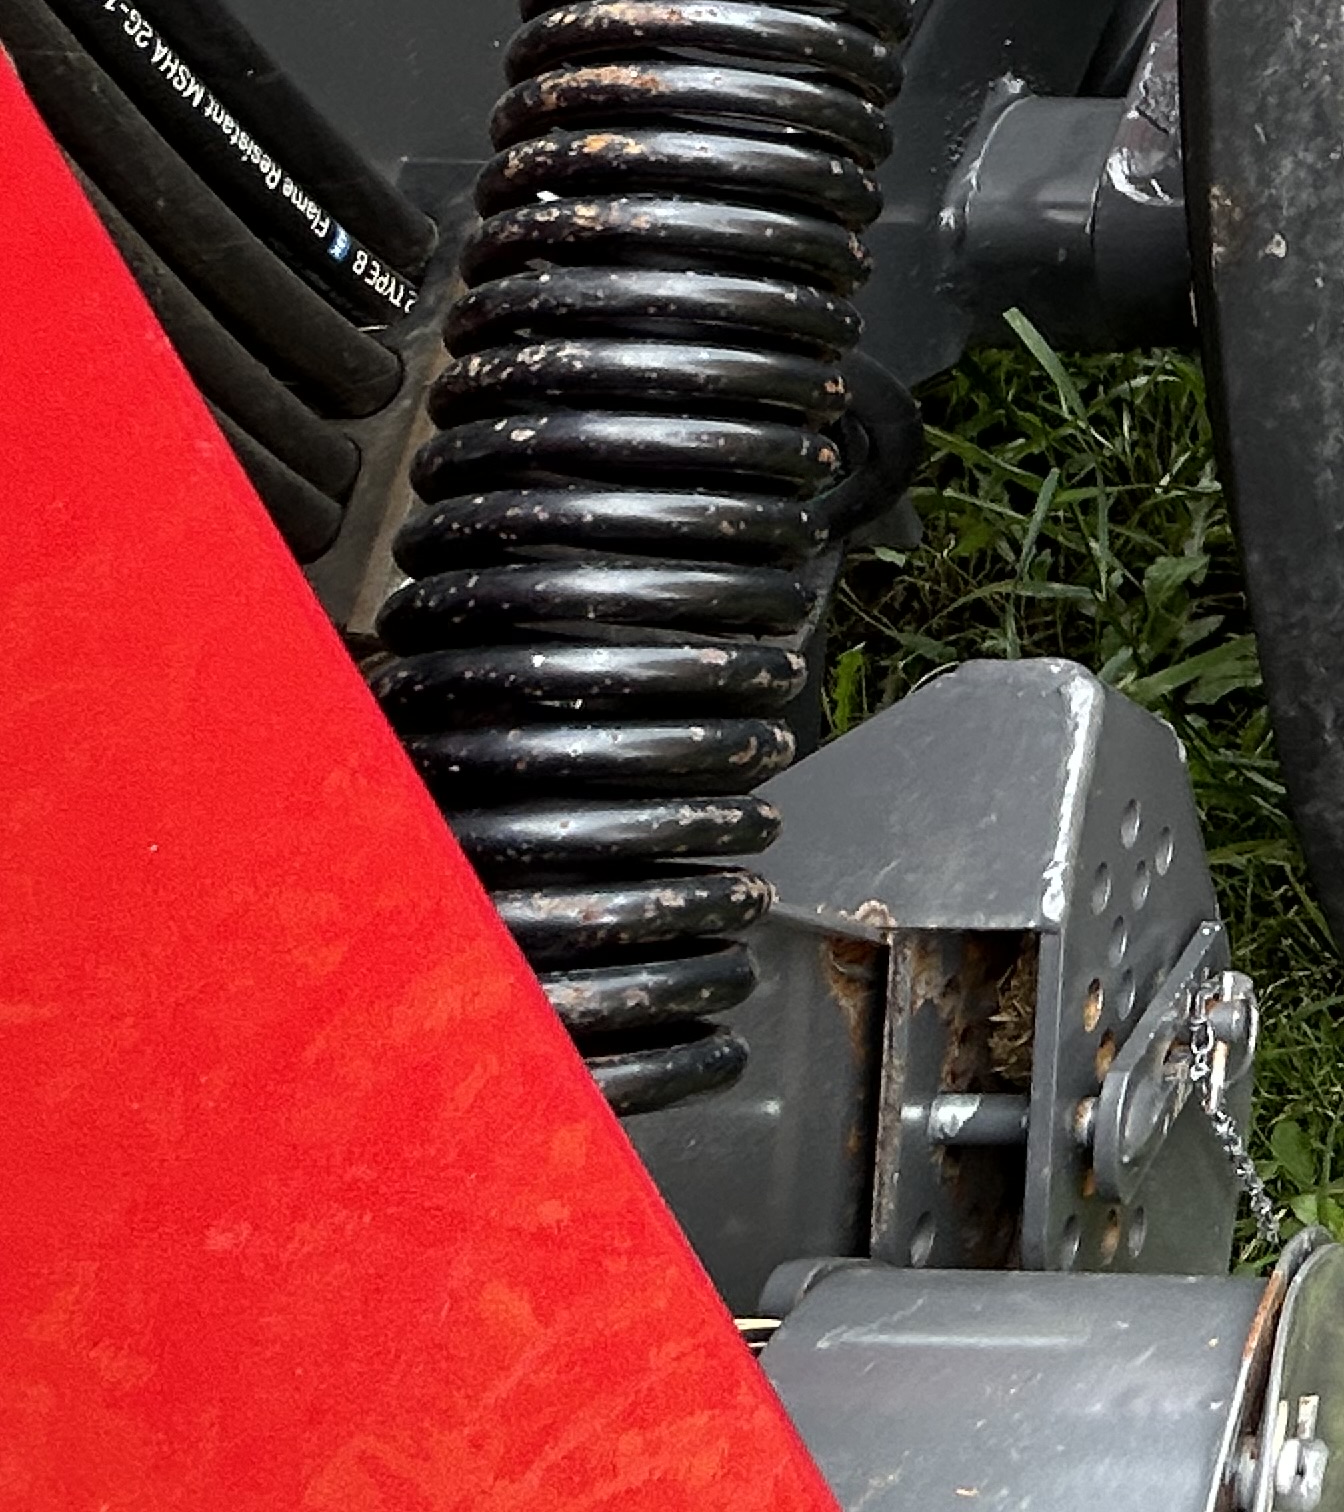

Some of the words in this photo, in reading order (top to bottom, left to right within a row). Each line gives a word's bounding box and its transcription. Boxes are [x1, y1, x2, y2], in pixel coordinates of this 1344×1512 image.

[151, 38, 206, 108] MSHA
[204, 94, 282, 190] Resistant
[282, 176, 331, 238] Flame
[364, 260, 405, 308] TYPE
